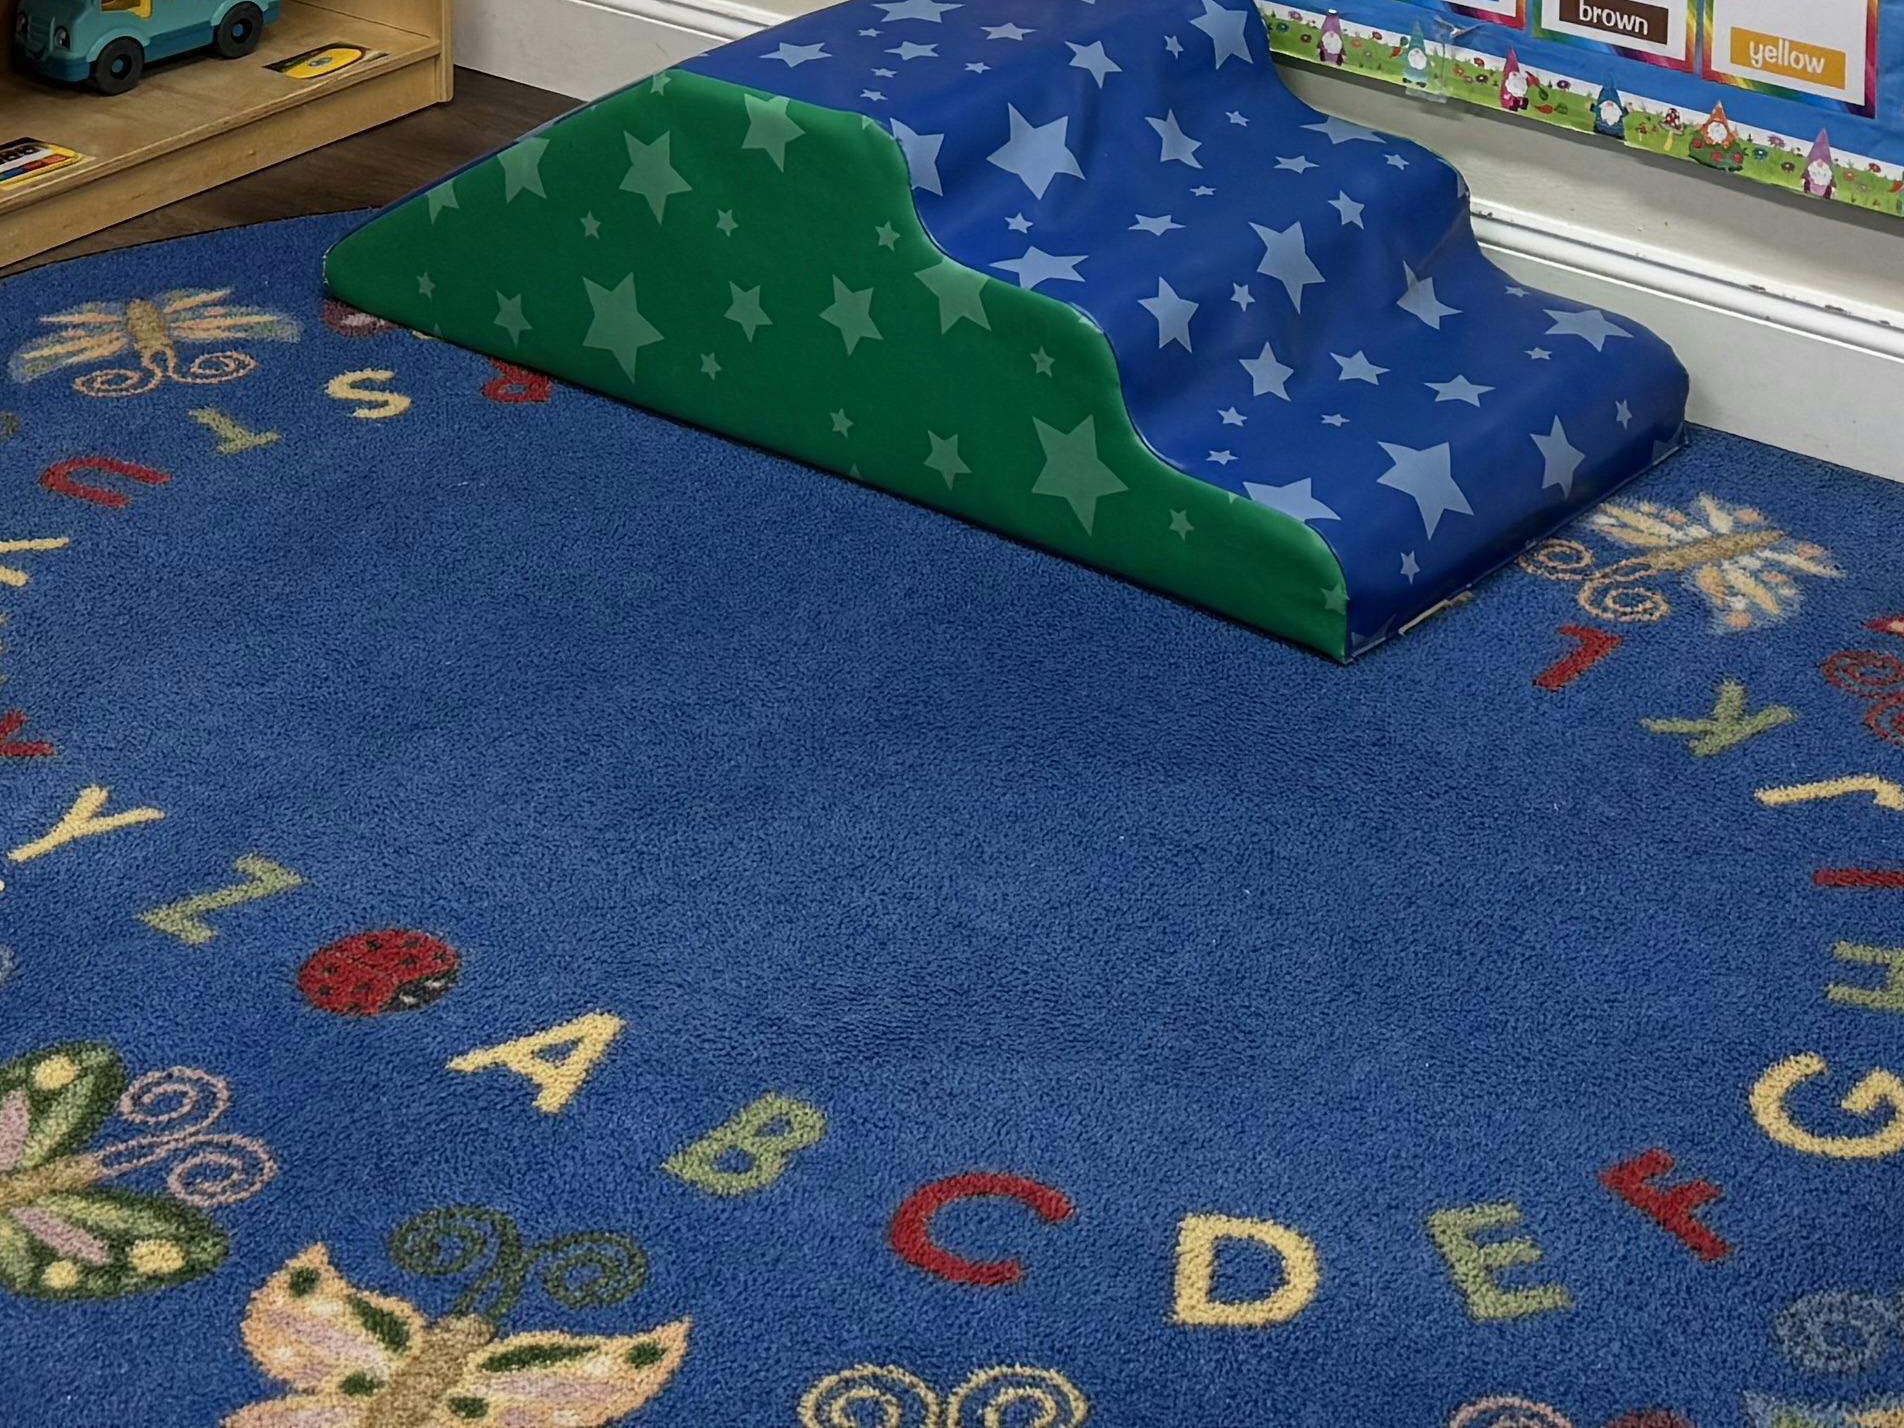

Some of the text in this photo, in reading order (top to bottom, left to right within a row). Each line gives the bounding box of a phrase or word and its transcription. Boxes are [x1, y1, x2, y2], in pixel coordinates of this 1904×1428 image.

[1750, 40, 1825, 74] yellow
[446, 1010, 626, 1114] A
[660, 1092, 827, 1196] B
[887, 1172, 1074, 1286] C
[1168, 1214, 1320, 1327] D
[1426, 1202, 1572, 1319] E
